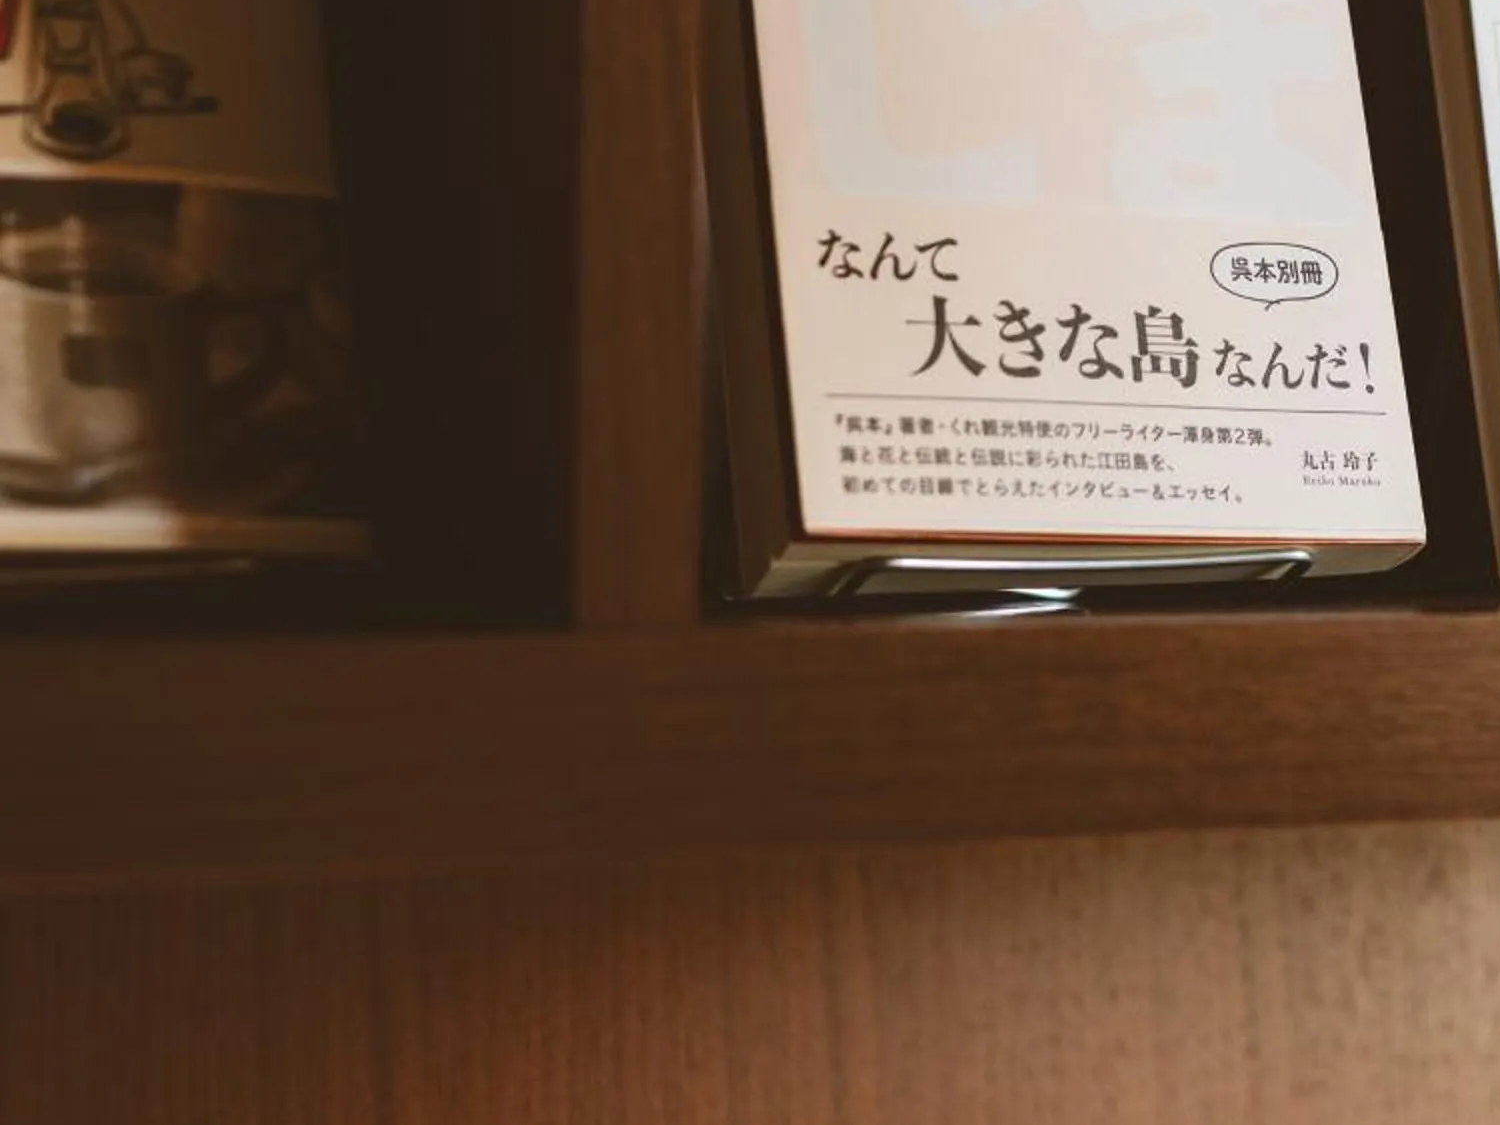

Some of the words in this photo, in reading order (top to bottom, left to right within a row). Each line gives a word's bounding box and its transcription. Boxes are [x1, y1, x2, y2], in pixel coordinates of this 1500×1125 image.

[817, 228, 960, 283] なんて
[1230, 256, 1325, 287] 呉本別冊
